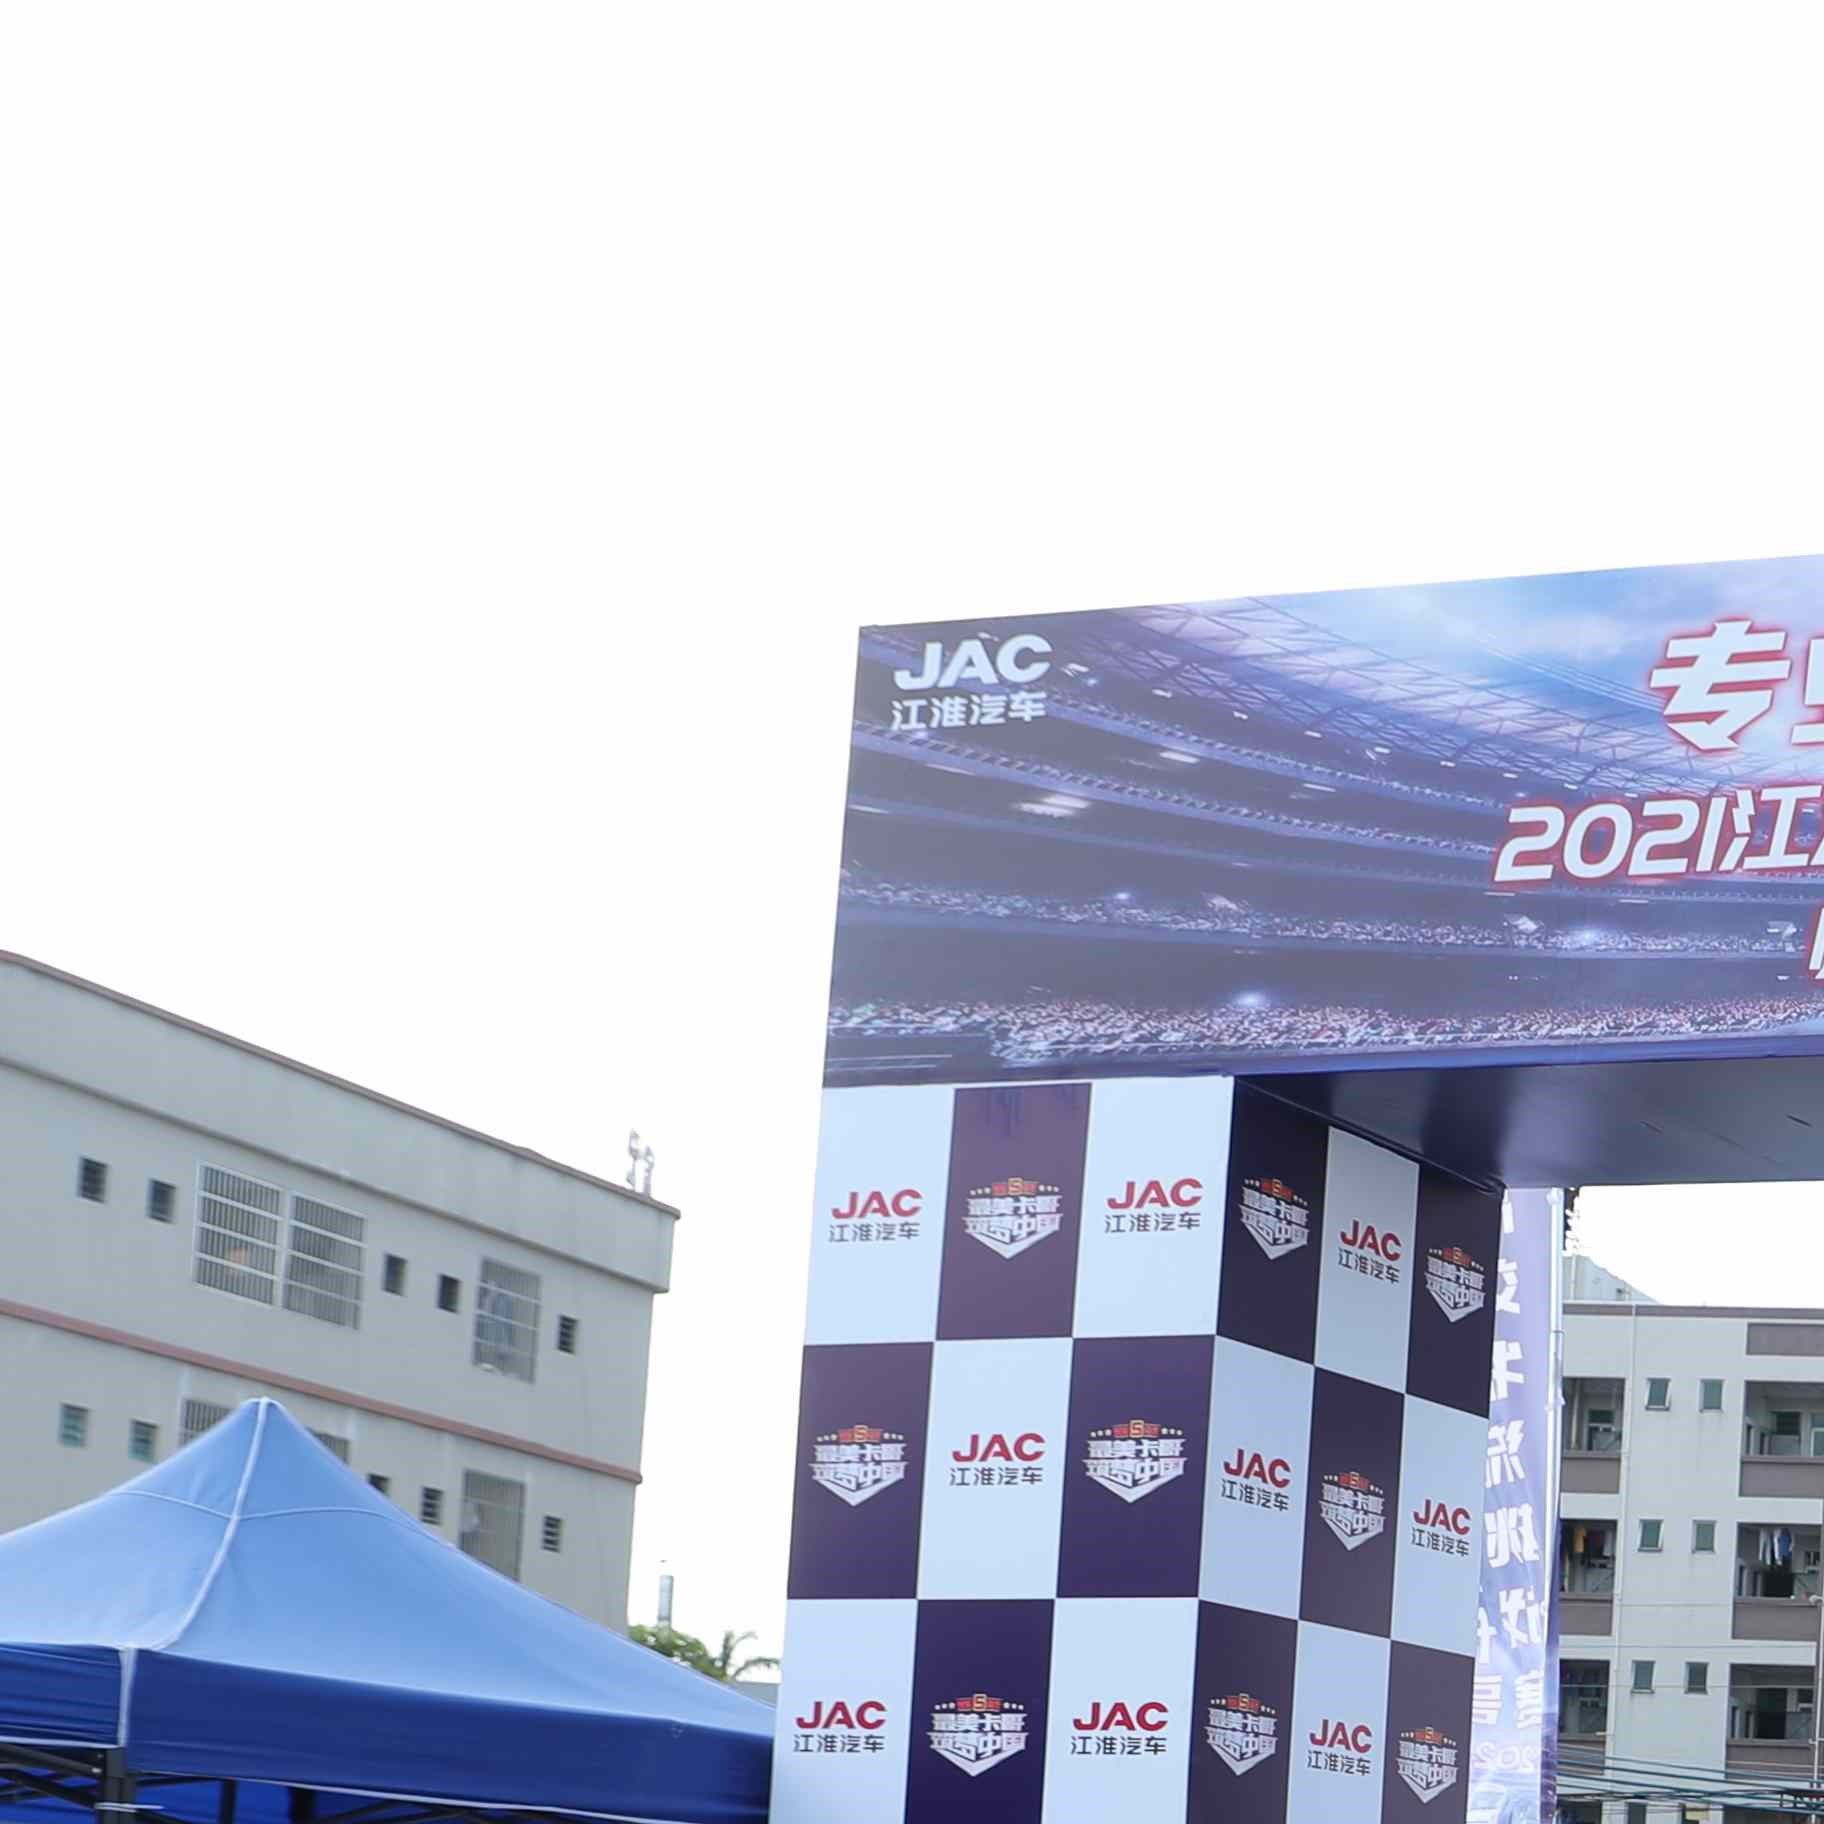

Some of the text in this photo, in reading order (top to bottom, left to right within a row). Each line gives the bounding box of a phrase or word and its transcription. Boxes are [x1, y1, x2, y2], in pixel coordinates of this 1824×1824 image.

[895, 634, 1051, 691] JAC
[891, 691, 1046, 733] 江淮汽车
[831, 1188, 922, 1219] JAC
[1106, 1177, 1202, 1210] JAC
[829, 1222, 920, 1242] 江淮汽车
[1104, 1212, 1201, 1234] 江淮汽车
[1339, 1225, 1403, 1262] JAC
[951, 1433, 1044, 1463] JAC
[950, 1466, 1043, 1486] 江淮汽车
[1223, 1451, 1291, 1489] JAC
[1413, 1503, 1472, 1536] JAC
[795, 1700, 885, 1730] JAC
[1074, 1701, 1167, 1732] JAC
[793, 1734, 885, 1753] 江淮汽车
[1071, 1735, 1167, 1755] 江淮汽车
[1310, 1723, 1372, 1754] JAC
